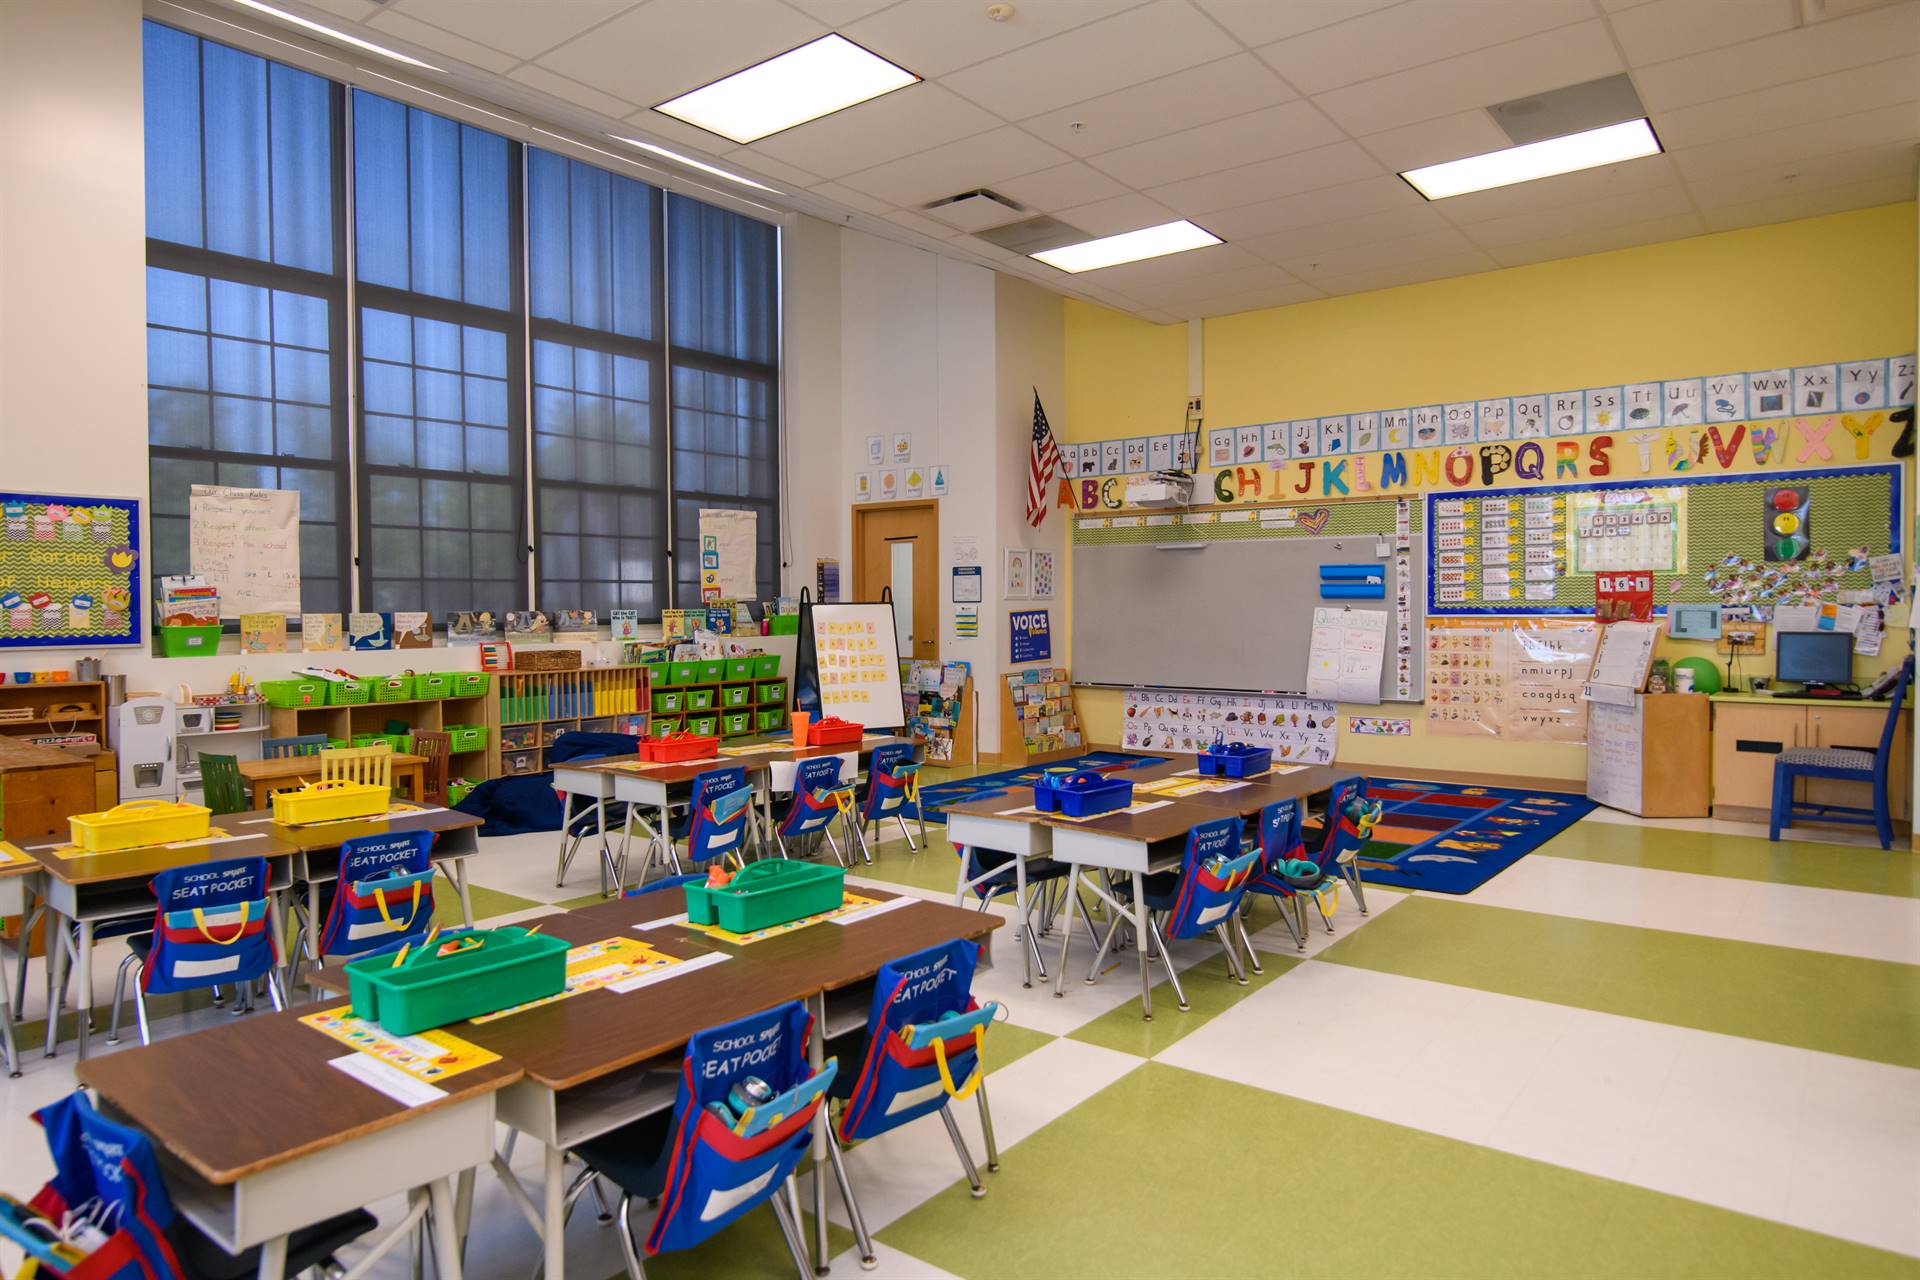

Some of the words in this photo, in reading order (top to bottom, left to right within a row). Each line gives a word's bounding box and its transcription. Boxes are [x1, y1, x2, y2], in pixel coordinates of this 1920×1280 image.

[1082, 480, 1098, 510] B
[1102, 478, 1122, 508] C
[1236, 467, 1262, 497] H
[1295, 462, 1315, 494] J
[1322, 460, 1349, 496] K
[1380, 452, 1407, 489] M
[1413, 450, 1440, 486] N
[1480, 445, 1512, 486] P
[1515, 442, 1544, 480] Q
[1556, 441, 1580, 479] R
[1589, 436, 1614, 476] S
[1627, 432, 1660, 473] T
[1708, 424, 1746, 469] V
[1796, 416, 1835, 463] X
[1841, 412, 1884, 460] Y
[29, 550, 100, 565] Garden
[36, 576, 113, 592] Helpers
[1012, 614, 1047, 631] VOICE
[357, 844, 387, 853] SCHOOL
[380, 848, 418, 863] POCKET
[184, 872, 220, 884] SCHOOL
[172, 885, 209, 900] SEAT
[210, 876, 255, 893] POCKET
[713, 1034, 756, 1053] SCHOOL
